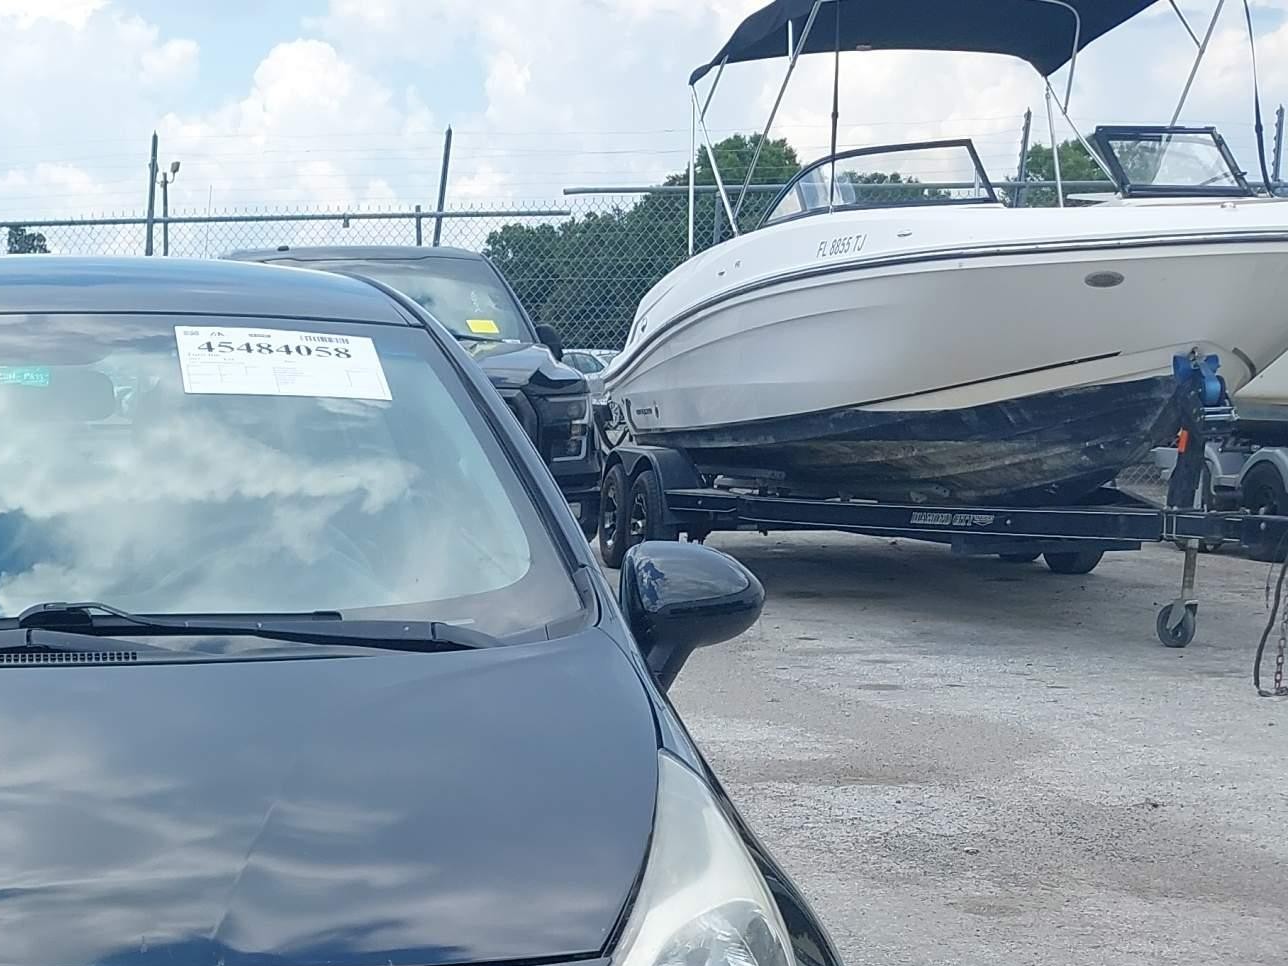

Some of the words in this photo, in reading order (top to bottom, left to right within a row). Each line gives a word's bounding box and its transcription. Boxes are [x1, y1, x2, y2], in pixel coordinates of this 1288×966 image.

[816, 240, 827, 258] FL
[829, 236, 853, 256] 8855
[853, 233, 867, 252] TJ
[197, 340, 352, 359] 45484058
